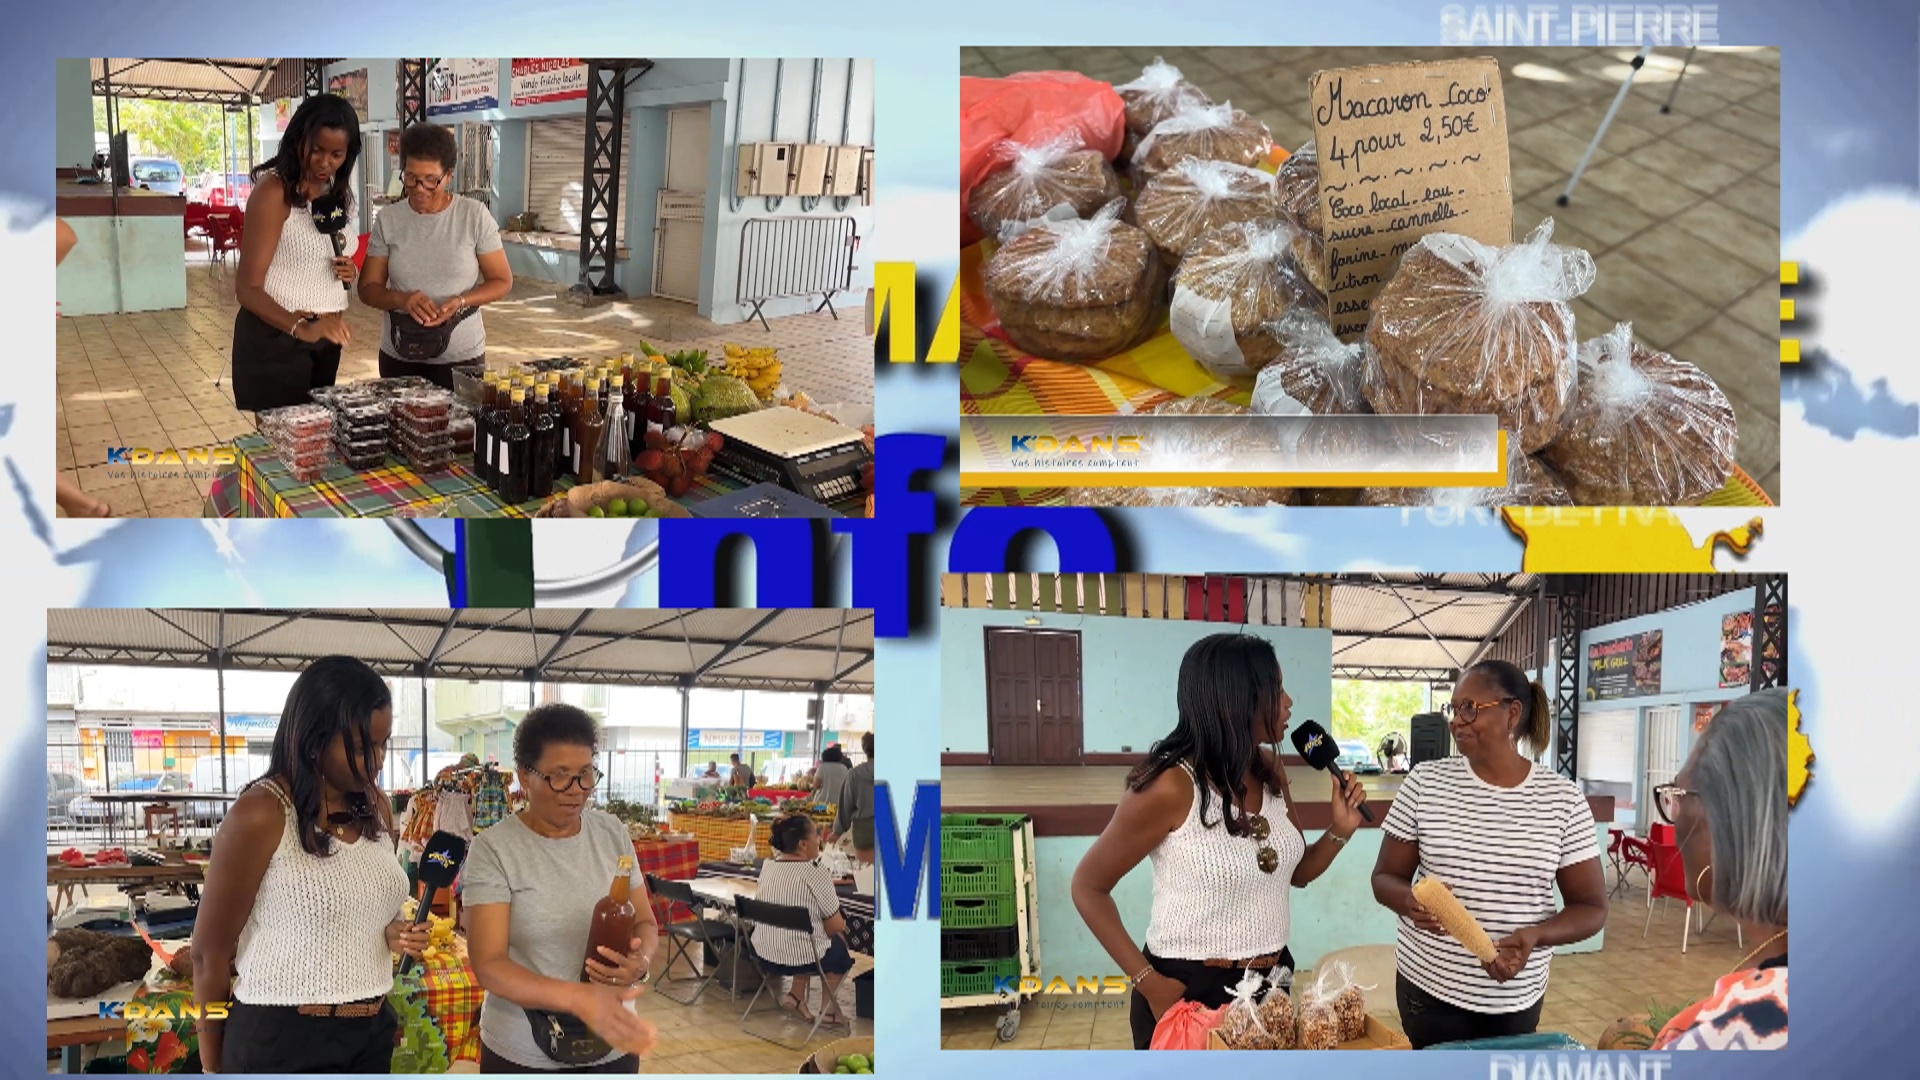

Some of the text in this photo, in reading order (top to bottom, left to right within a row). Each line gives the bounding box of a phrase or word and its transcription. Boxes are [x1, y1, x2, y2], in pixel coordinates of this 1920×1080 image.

[1317, 77, 1432, 126] Macaron
[1419, 112, 1479, 145] 2,50€
[729, 734, 761, 746] BZAR
